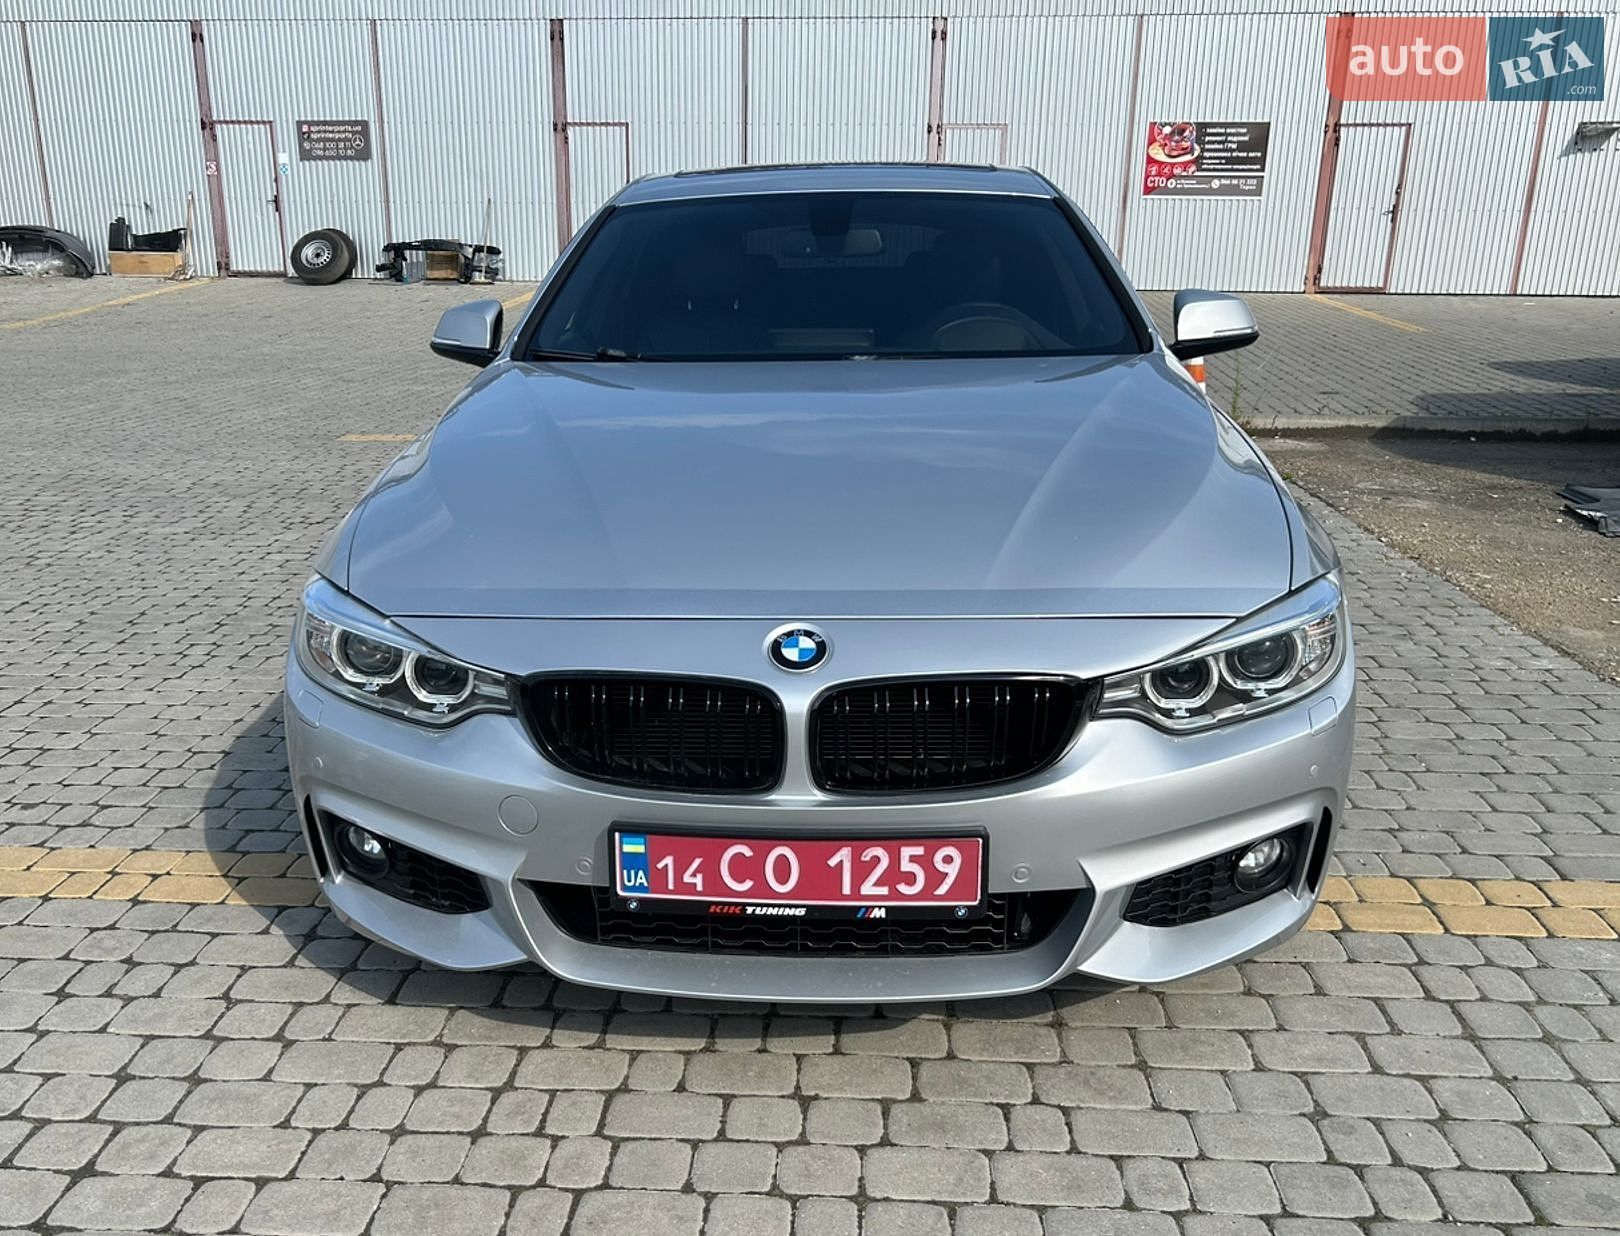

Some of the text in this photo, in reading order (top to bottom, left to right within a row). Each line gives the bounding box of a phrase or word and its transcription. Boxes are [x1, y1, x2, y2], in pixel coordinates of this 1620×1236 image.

[1146, 176, 1166, 187] СТО
[776, 629, 824, 643] BMW
[655, 844, 963, 896] 14 CO 1259
[623, 869, 648, 887] UA
[706, 904, 807, 916] KIK TUNING
